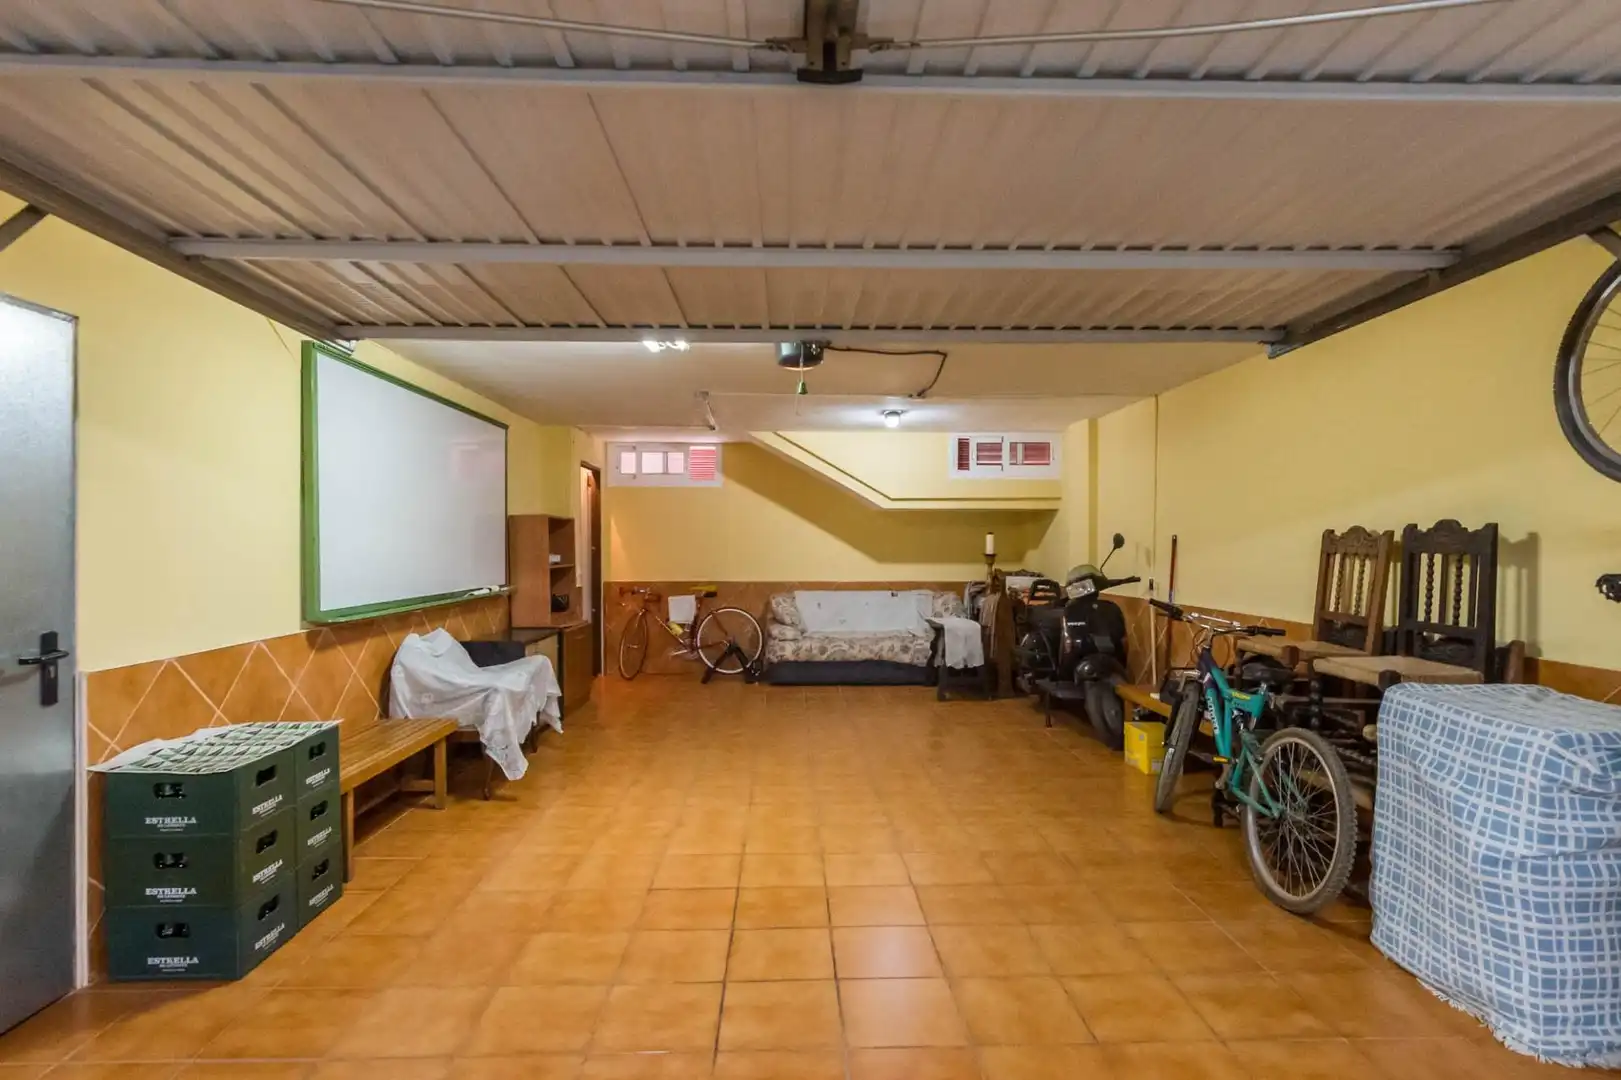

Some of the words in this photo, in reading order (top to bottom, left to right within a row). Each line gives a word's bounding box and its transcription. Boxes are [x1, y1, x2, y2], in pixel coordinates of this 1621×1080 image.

[252, 794, 283, 815] ESTRELLA
[144, 816, 197, 825] ESTRELLA
[252, 859, 283, 883] ESTRELLA
[145, 887, 198, 896] ESTRELLA
[254, 922, 285, 950] ESTRELLA
[147, 956, 200, 965] ESTRELLA
